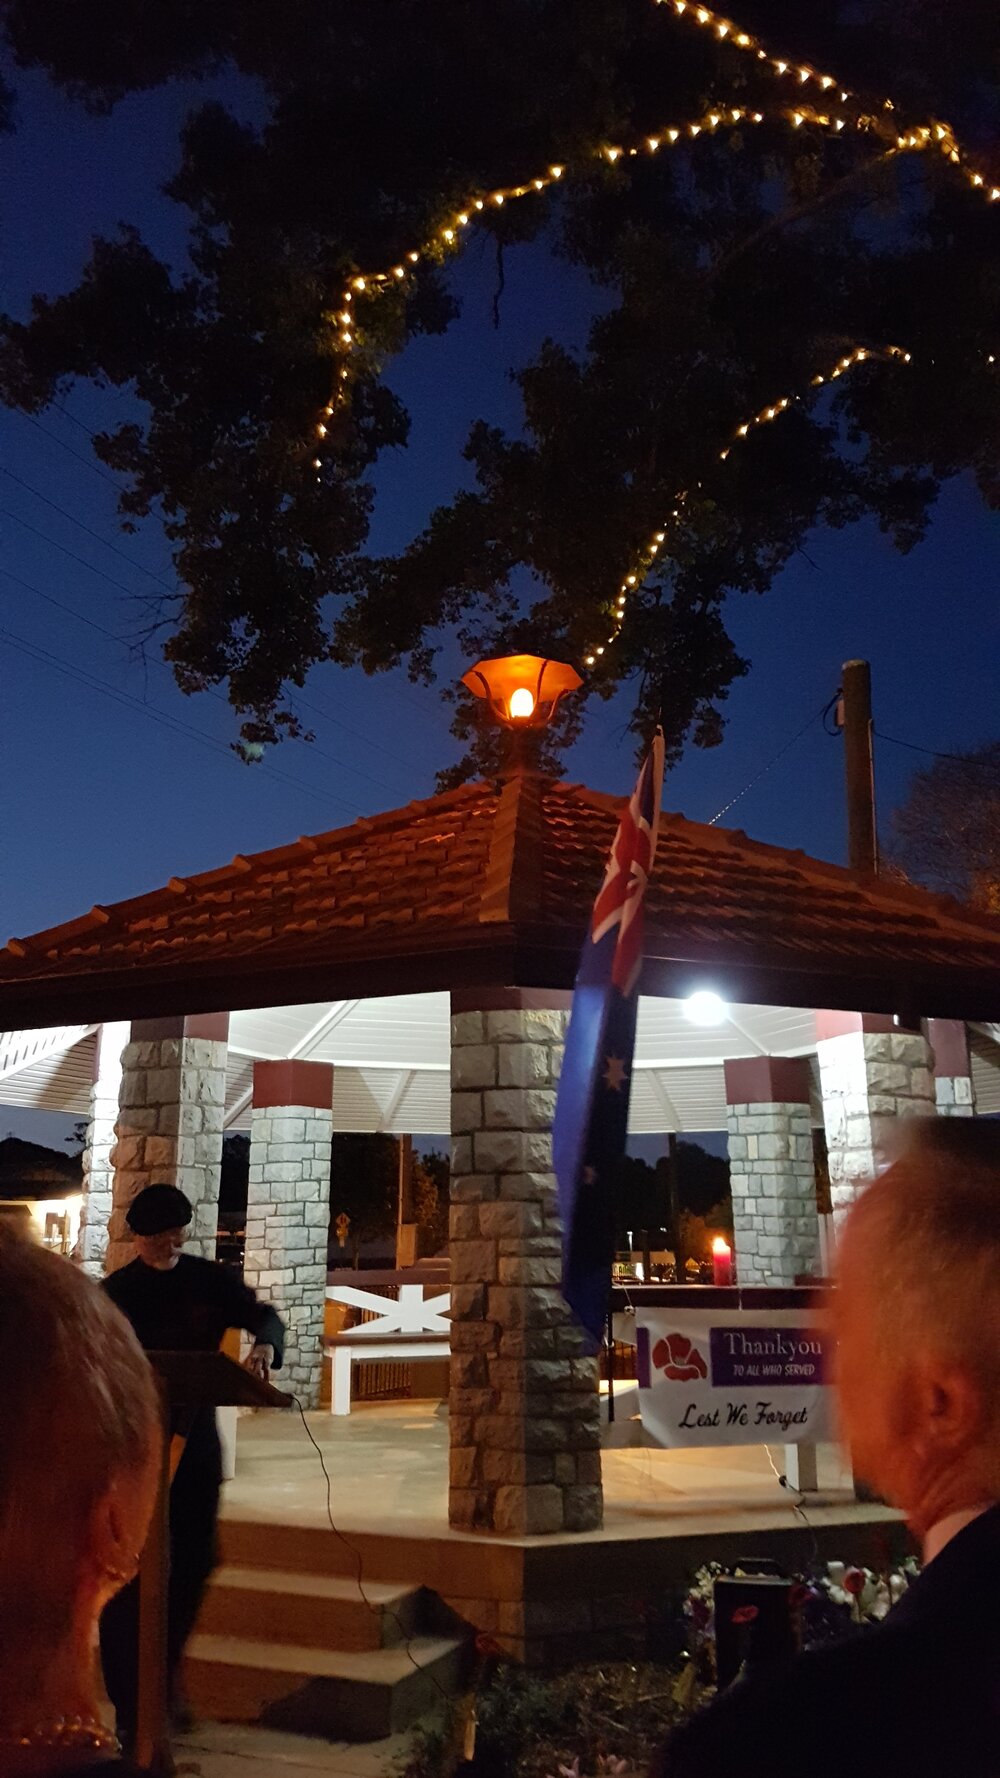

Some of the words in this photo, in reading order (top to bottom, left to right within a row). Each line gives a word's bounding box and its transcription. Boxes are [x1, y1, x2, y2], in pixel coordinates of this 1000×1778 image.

[723, 1333, 822, 1361] Thankyou
[733, 1364, 743, 1375] TO
[746, 1364, 760, 1375] ALL
[763, 1364, 782, 1375] WHO
[785, 1364, 815, 1376] SERVED
[679, 1403, 719, 1428] Lest
[726, 1402, 748, 1426] We
[754, 1402, 808, 1431] Forget
